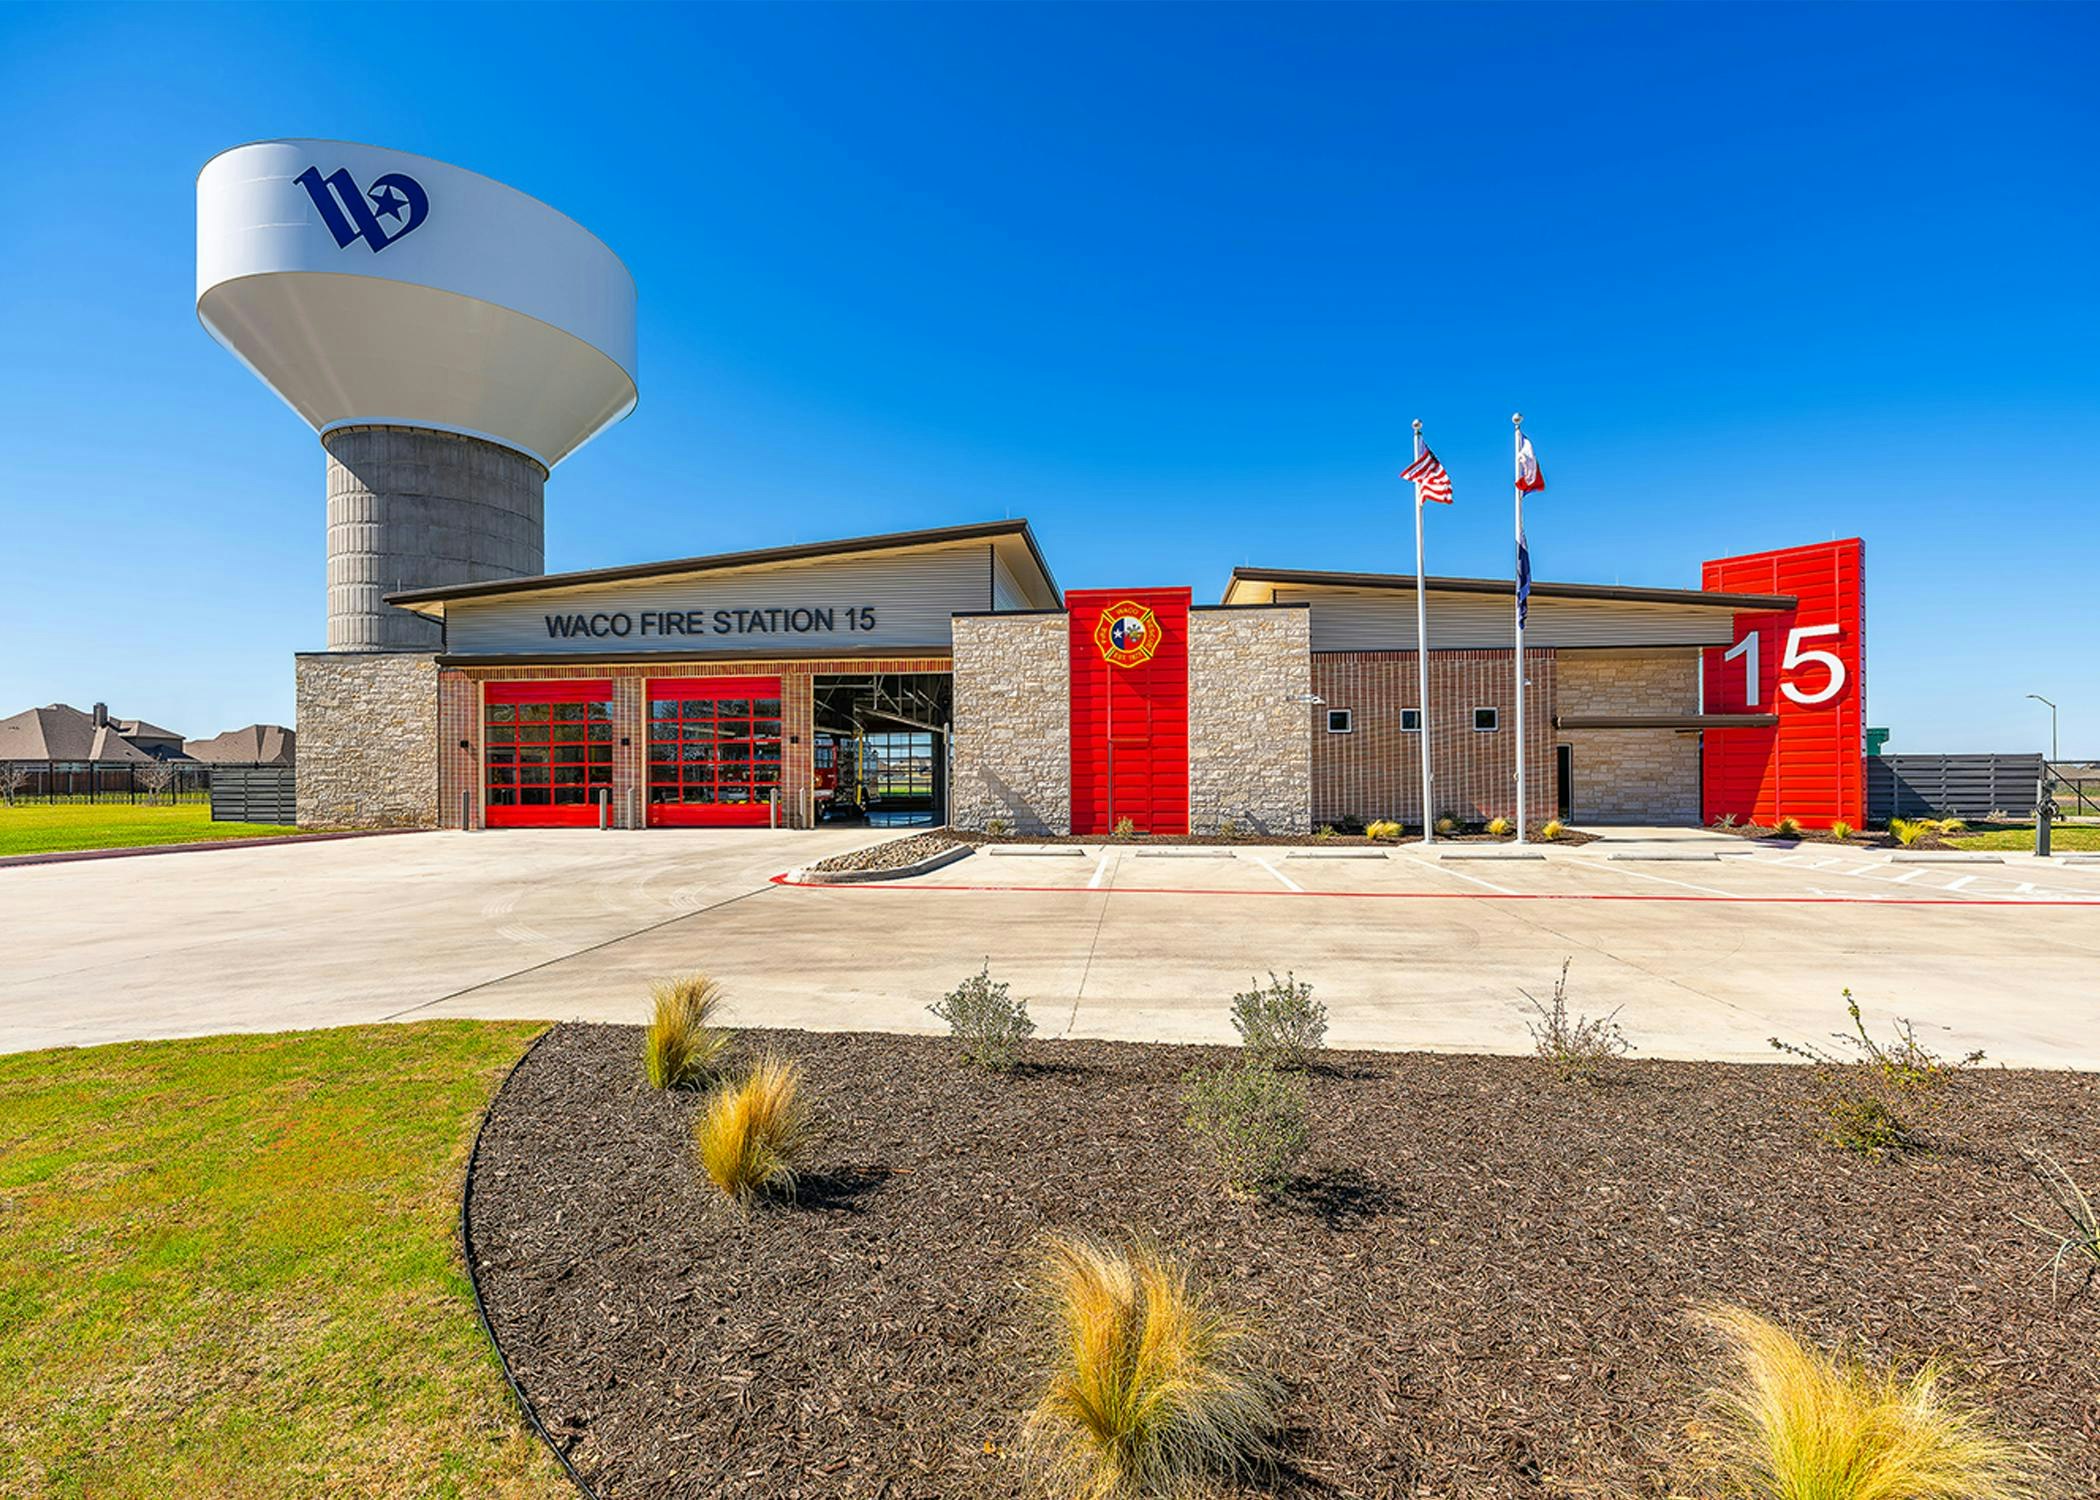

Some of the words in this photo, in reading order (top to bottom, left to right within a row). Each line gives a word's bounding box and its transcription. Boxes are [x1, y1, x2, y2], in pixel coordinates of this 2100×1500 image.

[545, 612, 632, 638] WACO
[640, 611, 705, 636] FIRE
[713, 608, 835, 634] STATION
[845, 607, 877, 631] 15
[1724, 623, 1846, 706] 15
